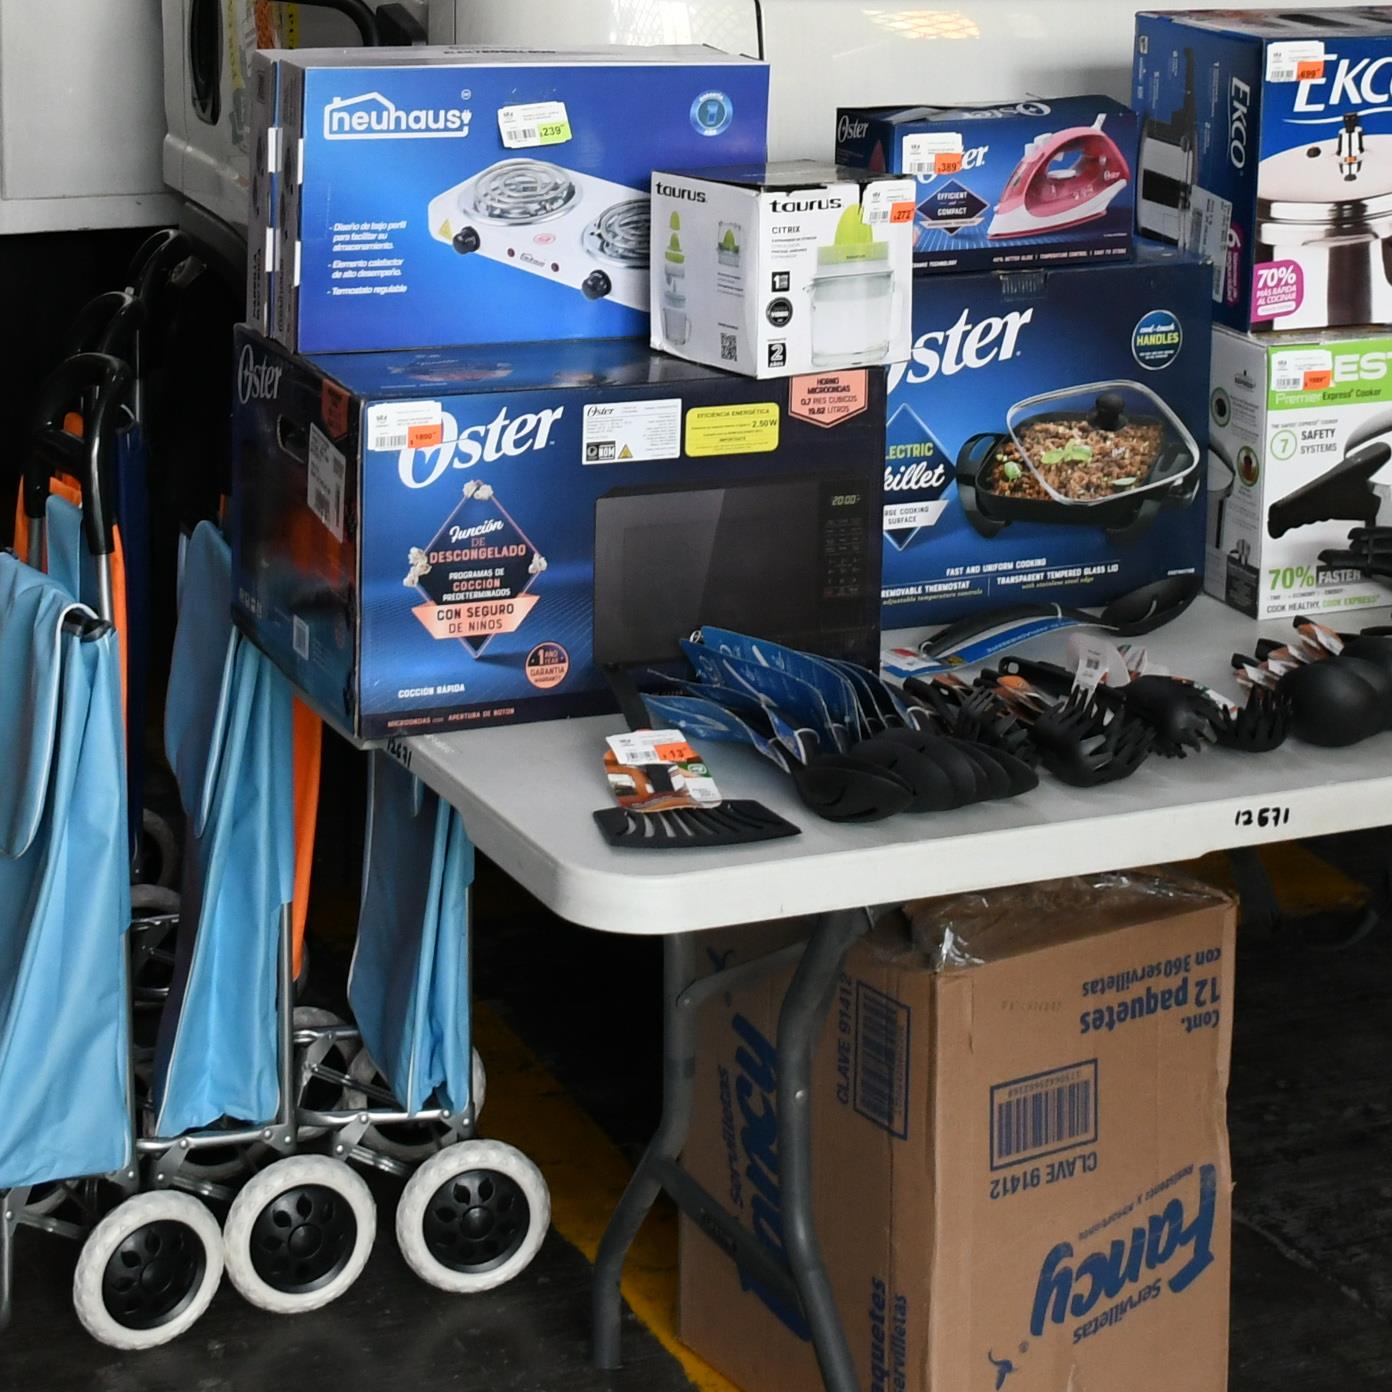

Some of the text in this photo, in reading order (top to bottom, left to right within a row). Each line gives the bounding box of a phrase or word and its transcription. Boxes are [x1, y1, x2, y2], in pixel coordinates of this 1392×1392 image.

[332, 108, 463, 132] neuhaus
[837, 115, 869, 143] Oster
[1230, 77, 1251, 170] EKCO
[656, 181, 706, 203] taurus
[937, 191, 968, 200] EFFICIENT
[769, 198, 842, 213] taurus
[937, 206, 968, 217] COMPACT
[771, 225, 801, 235] CITRIX
[1257, 265, 1296, 289] 70%
[1257, 296, 1266, 306] AL
[1136, 332, 1179, 346] HANDLES
[770, 345, 784, 360] 2
[237, 343, 283, 405] Oster
[587, 406, 615, 416] Oster
[1301, 428, 1336, 441] SAFETY
[398, 405, 565, 489] Oster
[886, 442, 933, 460] ECTRIC
[1300, 443, 1337, 455] SYSTEMS
[884, 464, 945, 492] killet
[900, 506, 929, 515] COOKING
[888, 515, 917, 525] SURFACE
[449, 519, 504, 543] Función
[471, 537, 485, 547] DE
[429, 544, 526, 564] DESCONGELADO
[449, 567, 504, 581] PROGRAMAS DE
[946, 567, 963, 577] FAST
[966, 565, 981, 574] AND
[983, 562, 1013, 573] UNIFORM
[997, 564, 1119, 585] TRANSPARENT TEMPERED GLASS LID
[1268, 565, 1315, 590] 70%
[442, 588, 511, 602] PREDETERMINADOS
[881, 581, 970, 599] REMOVABLE THERMOSTAT
[437, 603, 515, 621] CON SEGURO
[448, 623, 463, 633] DE
[537, 648, 544, 666] 1
[1195, 948, 1221, 966] con
[1080, 977, 1220, 1034] 12 paquetes
[1181, 1009, 1220, 1034] Cont.
[837, 1036, 853, 1105] CLAVE
[989, 1151, 1098, 1201] CLAVE 91412
[1029, 1163, 1217, 1337] Fancy
[871, 1276, 888, 1392] aquetes
